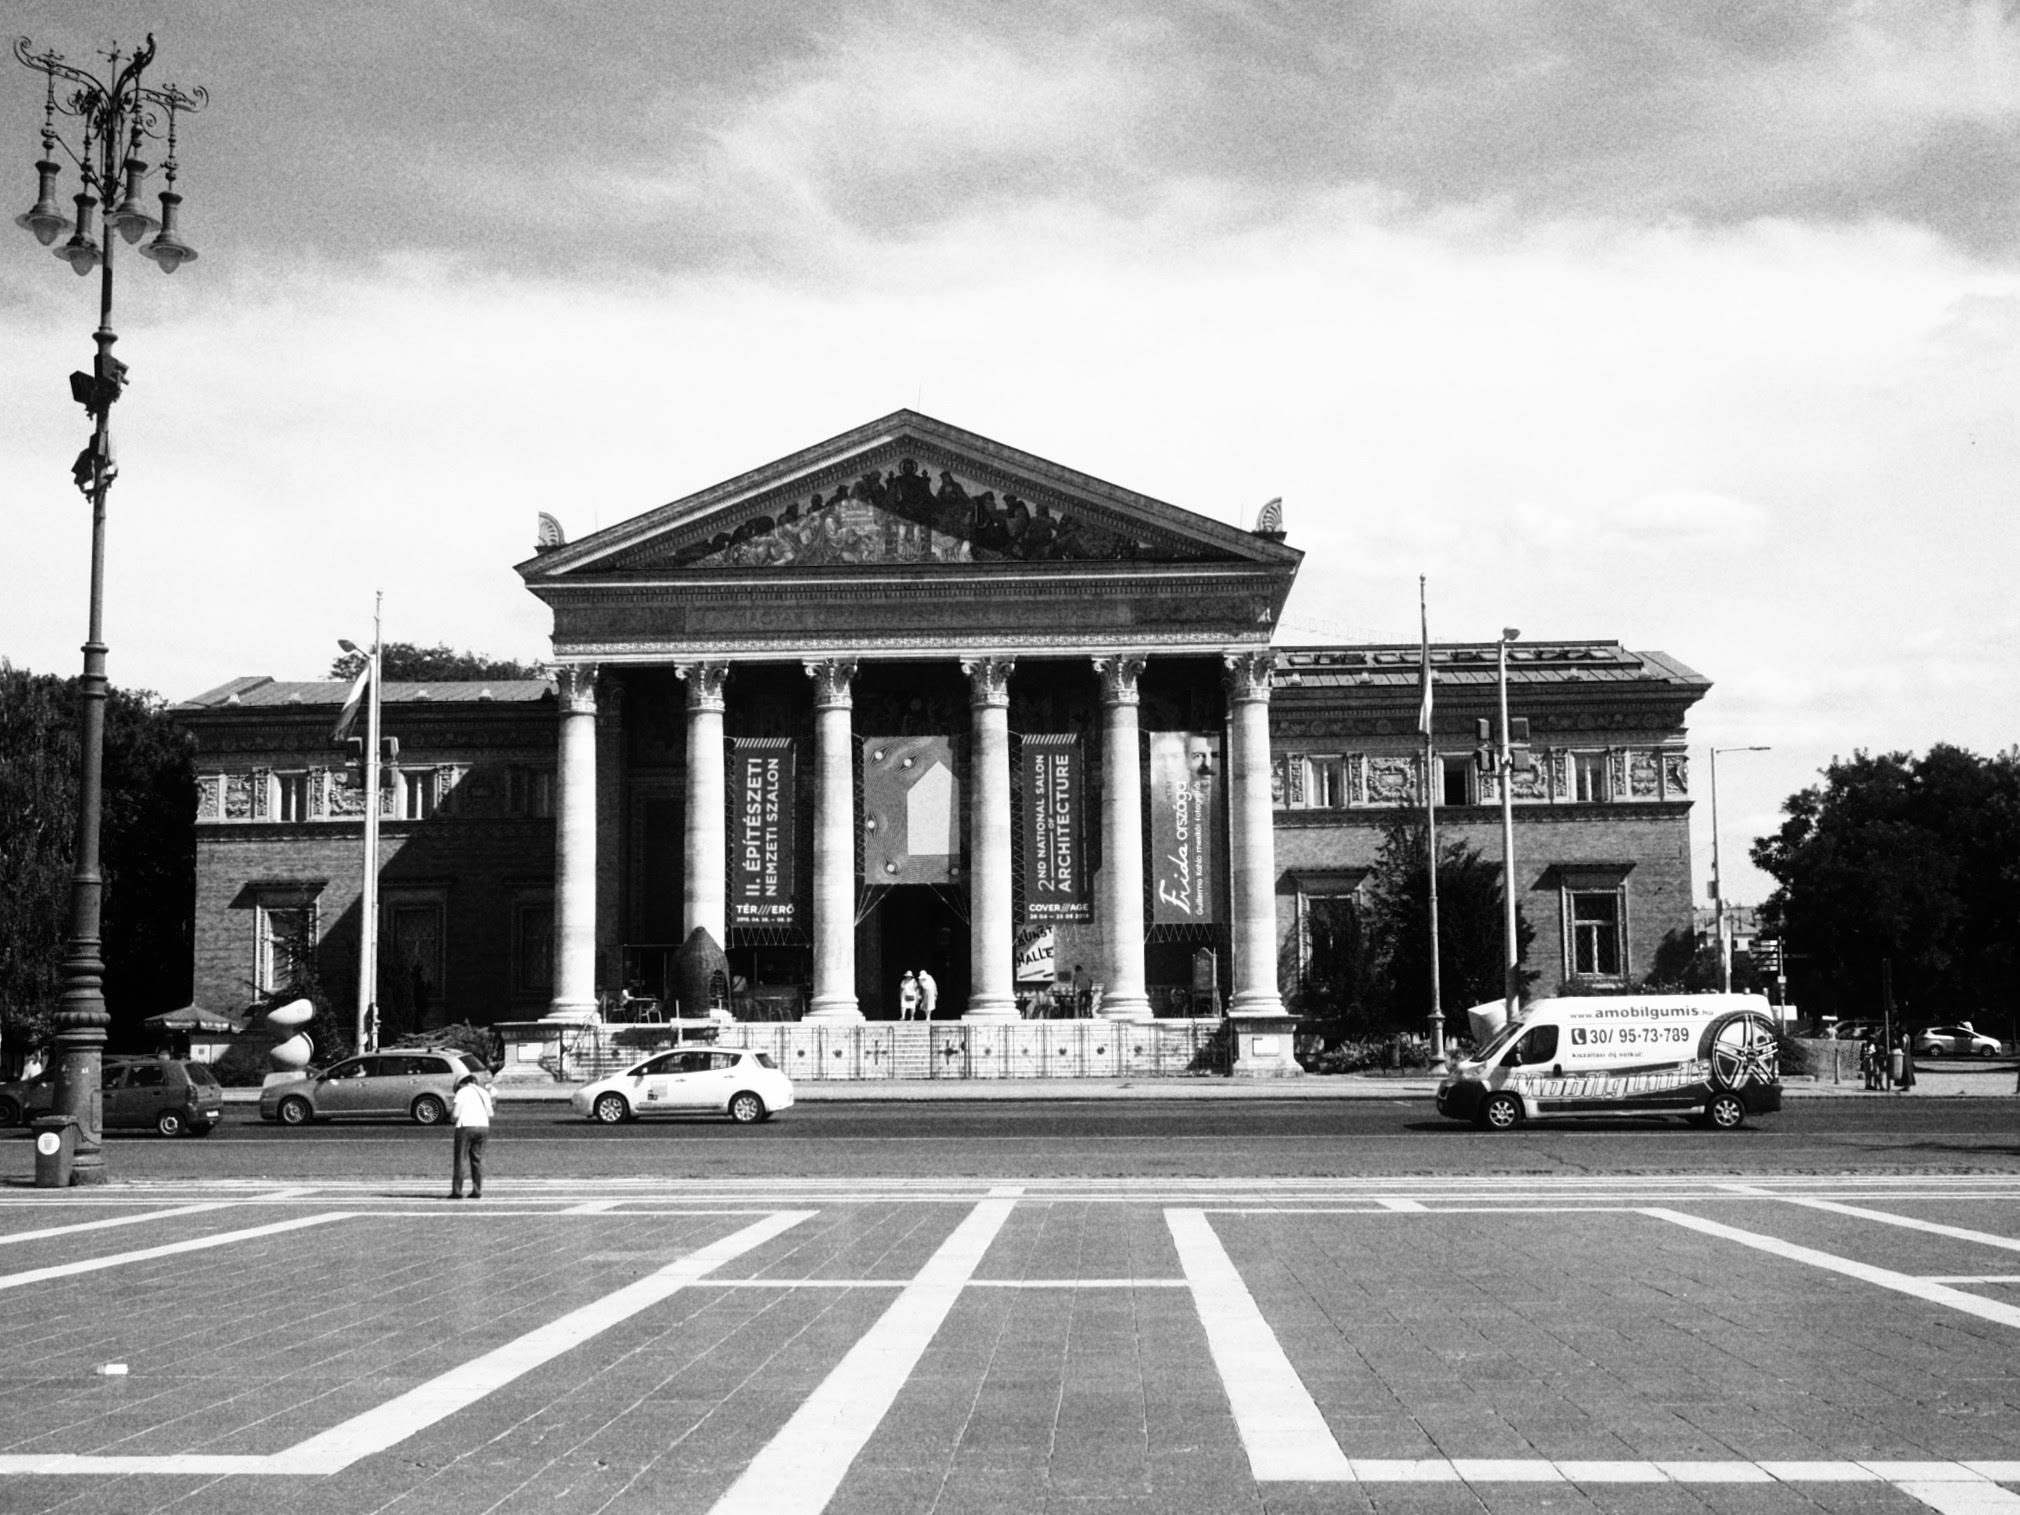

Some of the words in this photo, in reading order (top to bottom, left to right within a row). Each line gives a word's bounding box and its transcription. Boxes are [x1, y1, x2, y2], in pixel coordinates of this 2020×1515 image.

[766, 758, 779, 822] SZALON
[1035, 755, 1045, 795] SALON
[742, 758, 762, 872] ÉPÍTÉSZETI
[1036, 798, 1046, 858] NATIONAL
[1055, 754, 1072, 892] ARCHITECTURE
[1172, 781, 1192, 841] országa
[745, 878, 761, 896] II.
[765, 827, 778, 896] NEMZETI
[1037, 861, 1055, 892] 2ND
[1158, 842, 1191, 915] Frida
[1570, 1004, 1714, 1020] www.amobilgumis.hu
[1590, 1029, 1614, 1044] 30/
[1512, 1059, 1712, 1100] Mobilgumis
